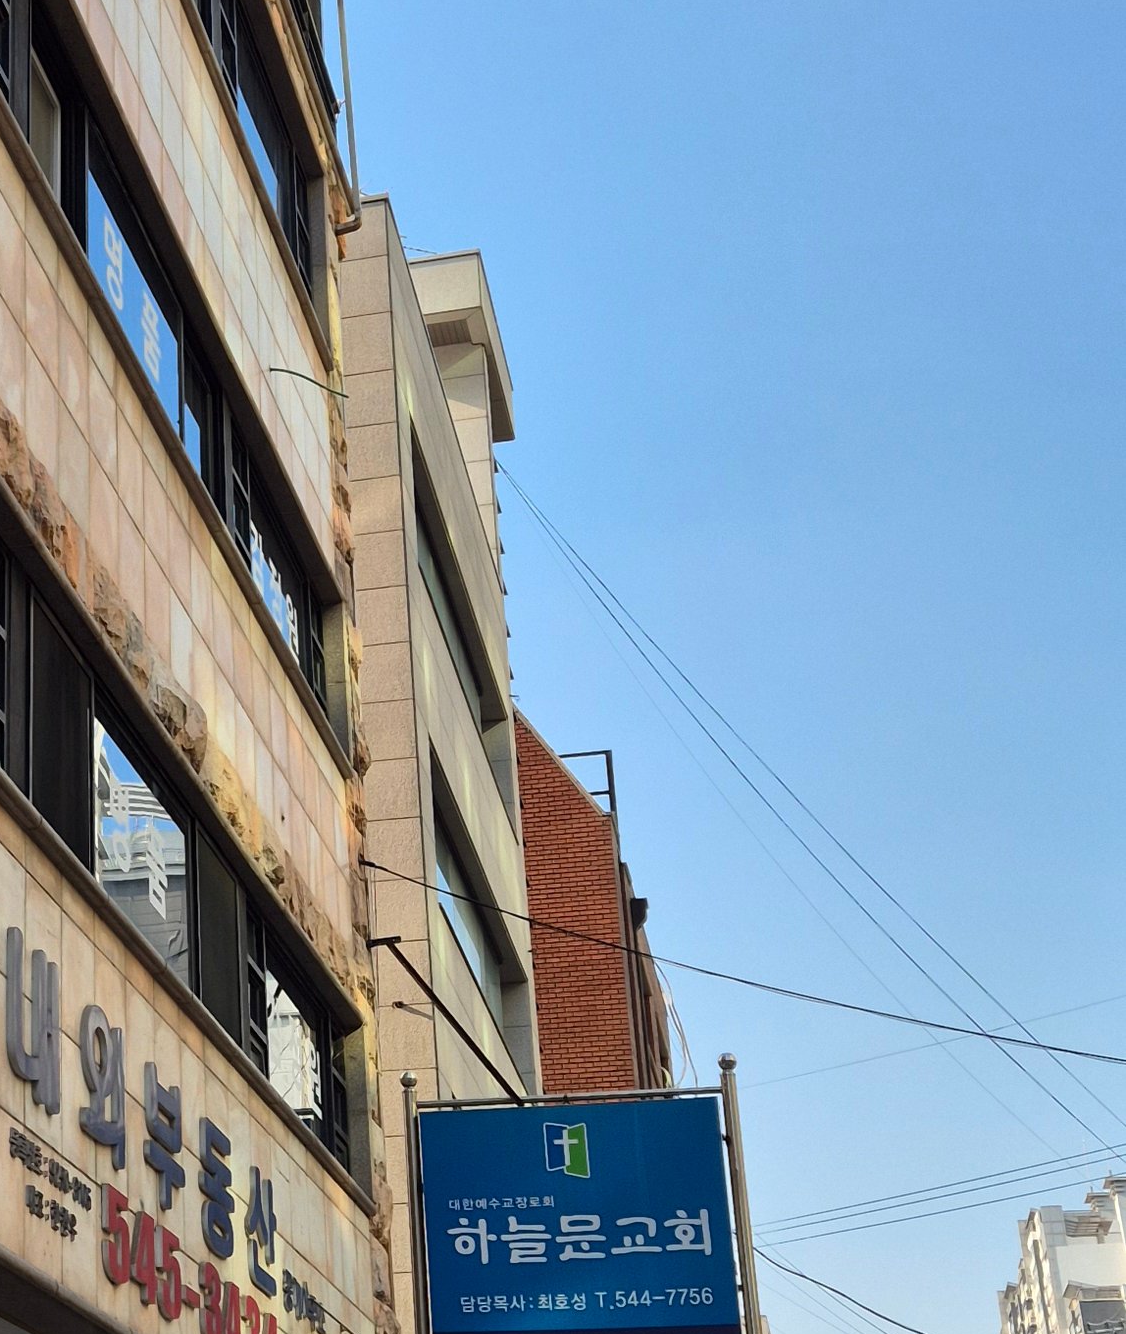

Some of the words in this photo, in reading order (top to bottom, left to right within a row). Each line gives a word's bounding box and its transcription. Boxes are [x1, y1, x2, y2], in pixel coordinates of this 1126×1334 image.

[6, 926, 277, 1298] 내외부동산
[448, 1195, 555, 1211] 대한예수교장로회
[447, 1208, 712, 1265] 하늘문교회
[537, 1292, 587, 1311] 최호성
